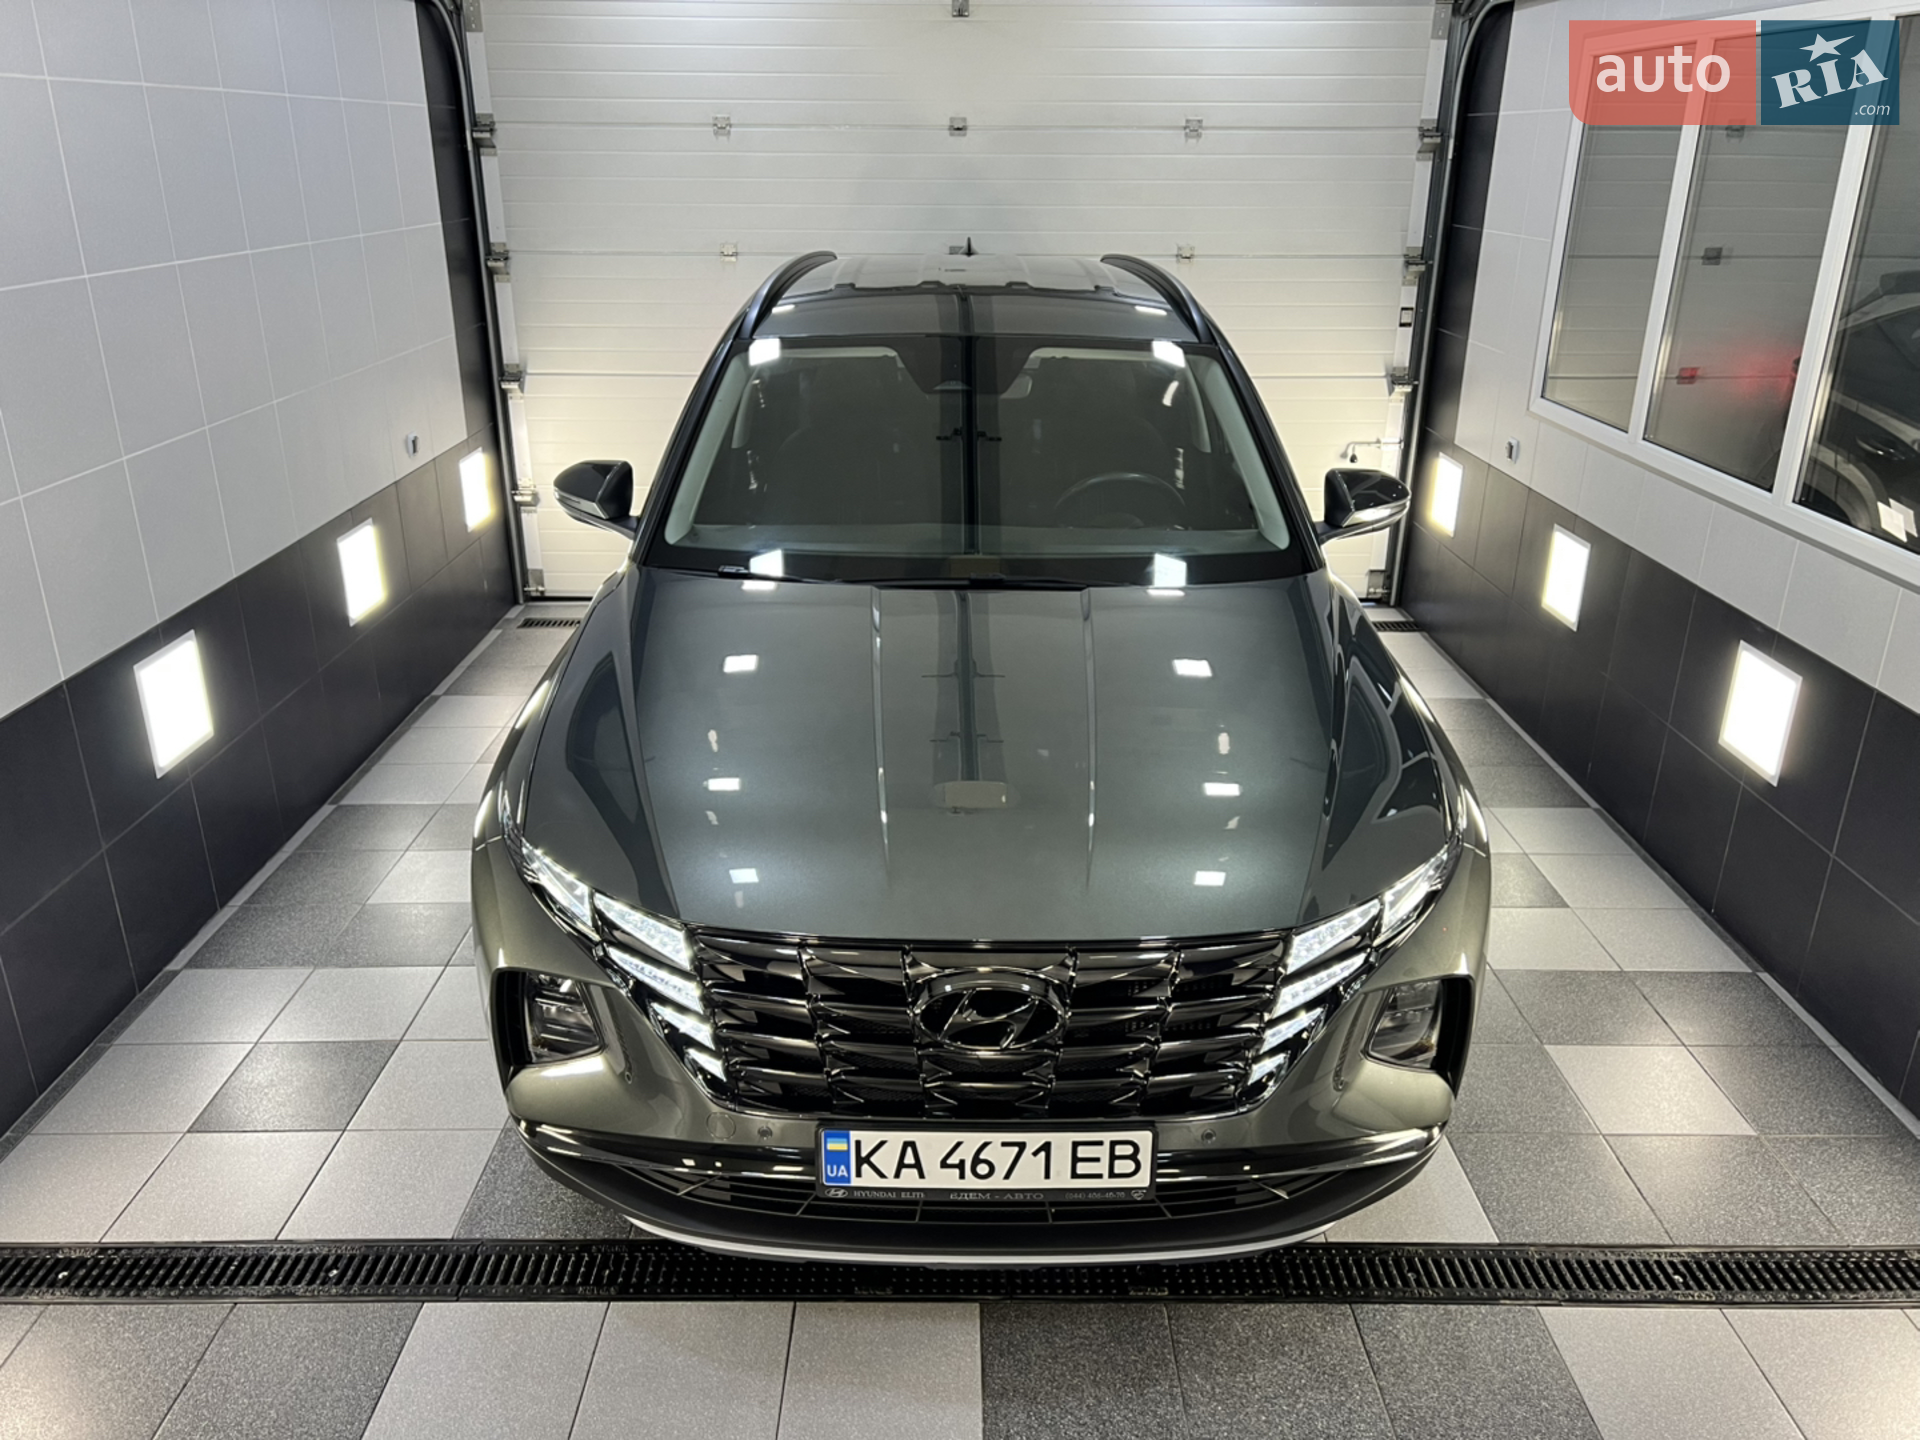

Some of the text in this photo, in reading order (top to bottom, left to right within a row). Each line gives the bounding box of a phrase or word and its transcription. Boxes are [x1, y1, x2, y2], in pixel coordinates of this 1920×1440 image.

[854, 1139, 1142, 1181] KA 4671 EB
[827, 1164, 848, 1178] UA
[853, 1190, 897, 1199] HYUNDAI
